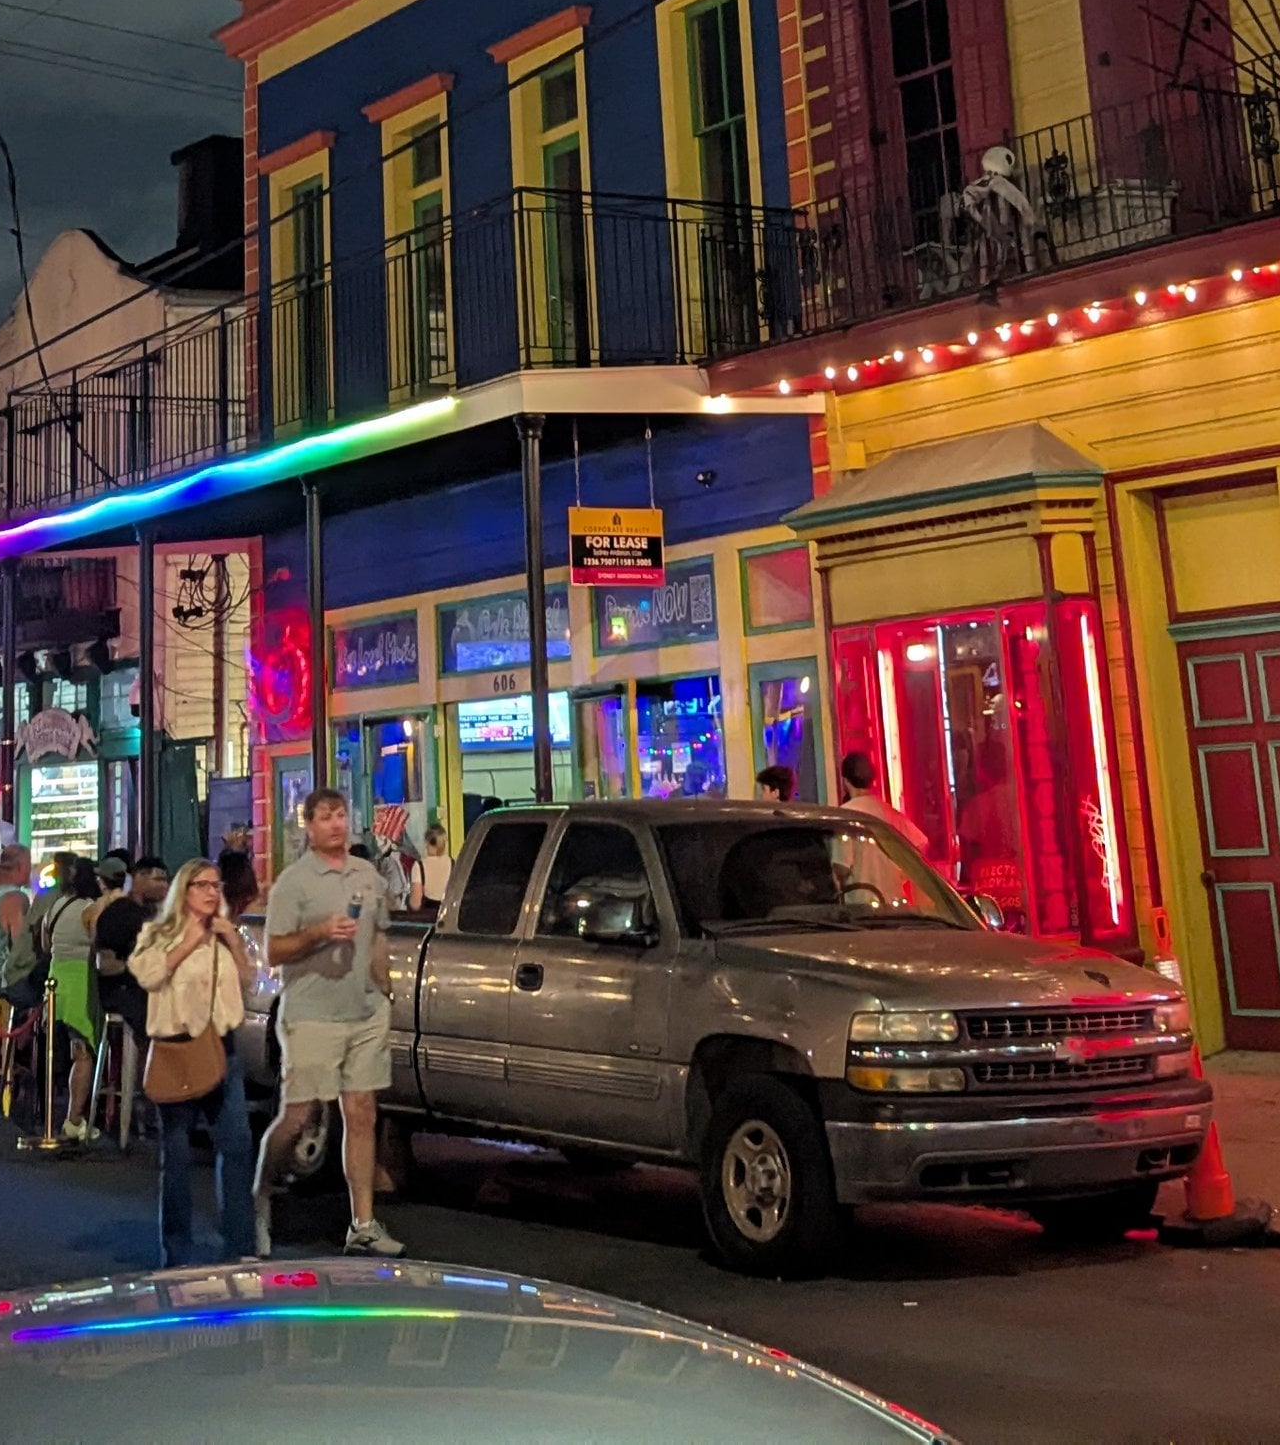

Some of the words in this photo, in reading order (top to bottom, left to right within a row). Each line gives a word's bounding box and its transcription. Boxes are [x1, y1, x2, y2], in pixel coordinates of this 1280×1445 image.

[585, 536, 610, 548] FOR
[613, 536, 648, 550] LEASE
[652, 581, 689, 626] NOW
[493, 674, 516, 692] 606
